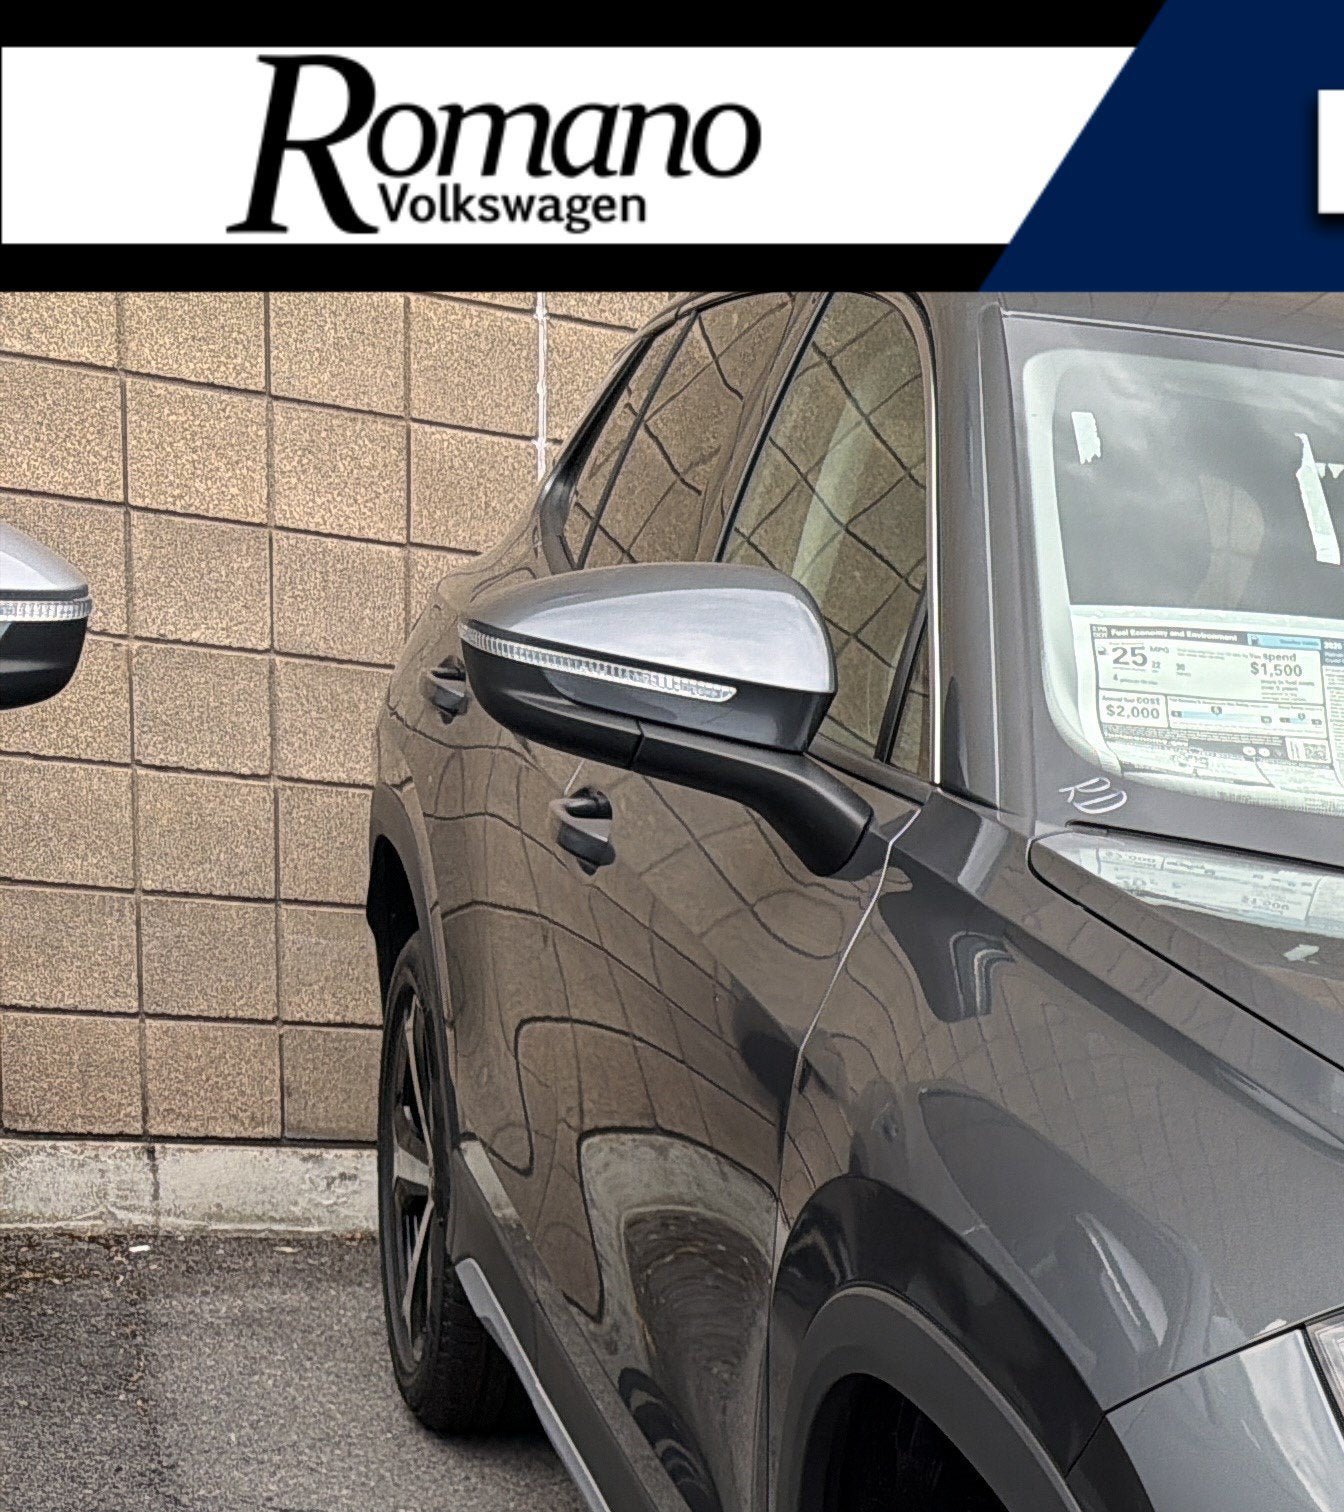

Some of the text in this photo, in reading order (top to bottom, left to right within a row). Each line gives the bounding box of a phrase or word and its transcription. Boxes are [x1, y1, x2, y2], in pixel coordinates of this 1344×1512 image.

[1110, 628, 1129, 637] Fuel
[1130, 629, 1168, 639] Economy
[1186, 631, 1238, 642] Environment
[1111, 646, 1148, 667] 25
[1262, 652, 1297, 663] spend
[1249, 661, 1303, 678] $1,500
[1106, 704, 1160, 720] $2,000
